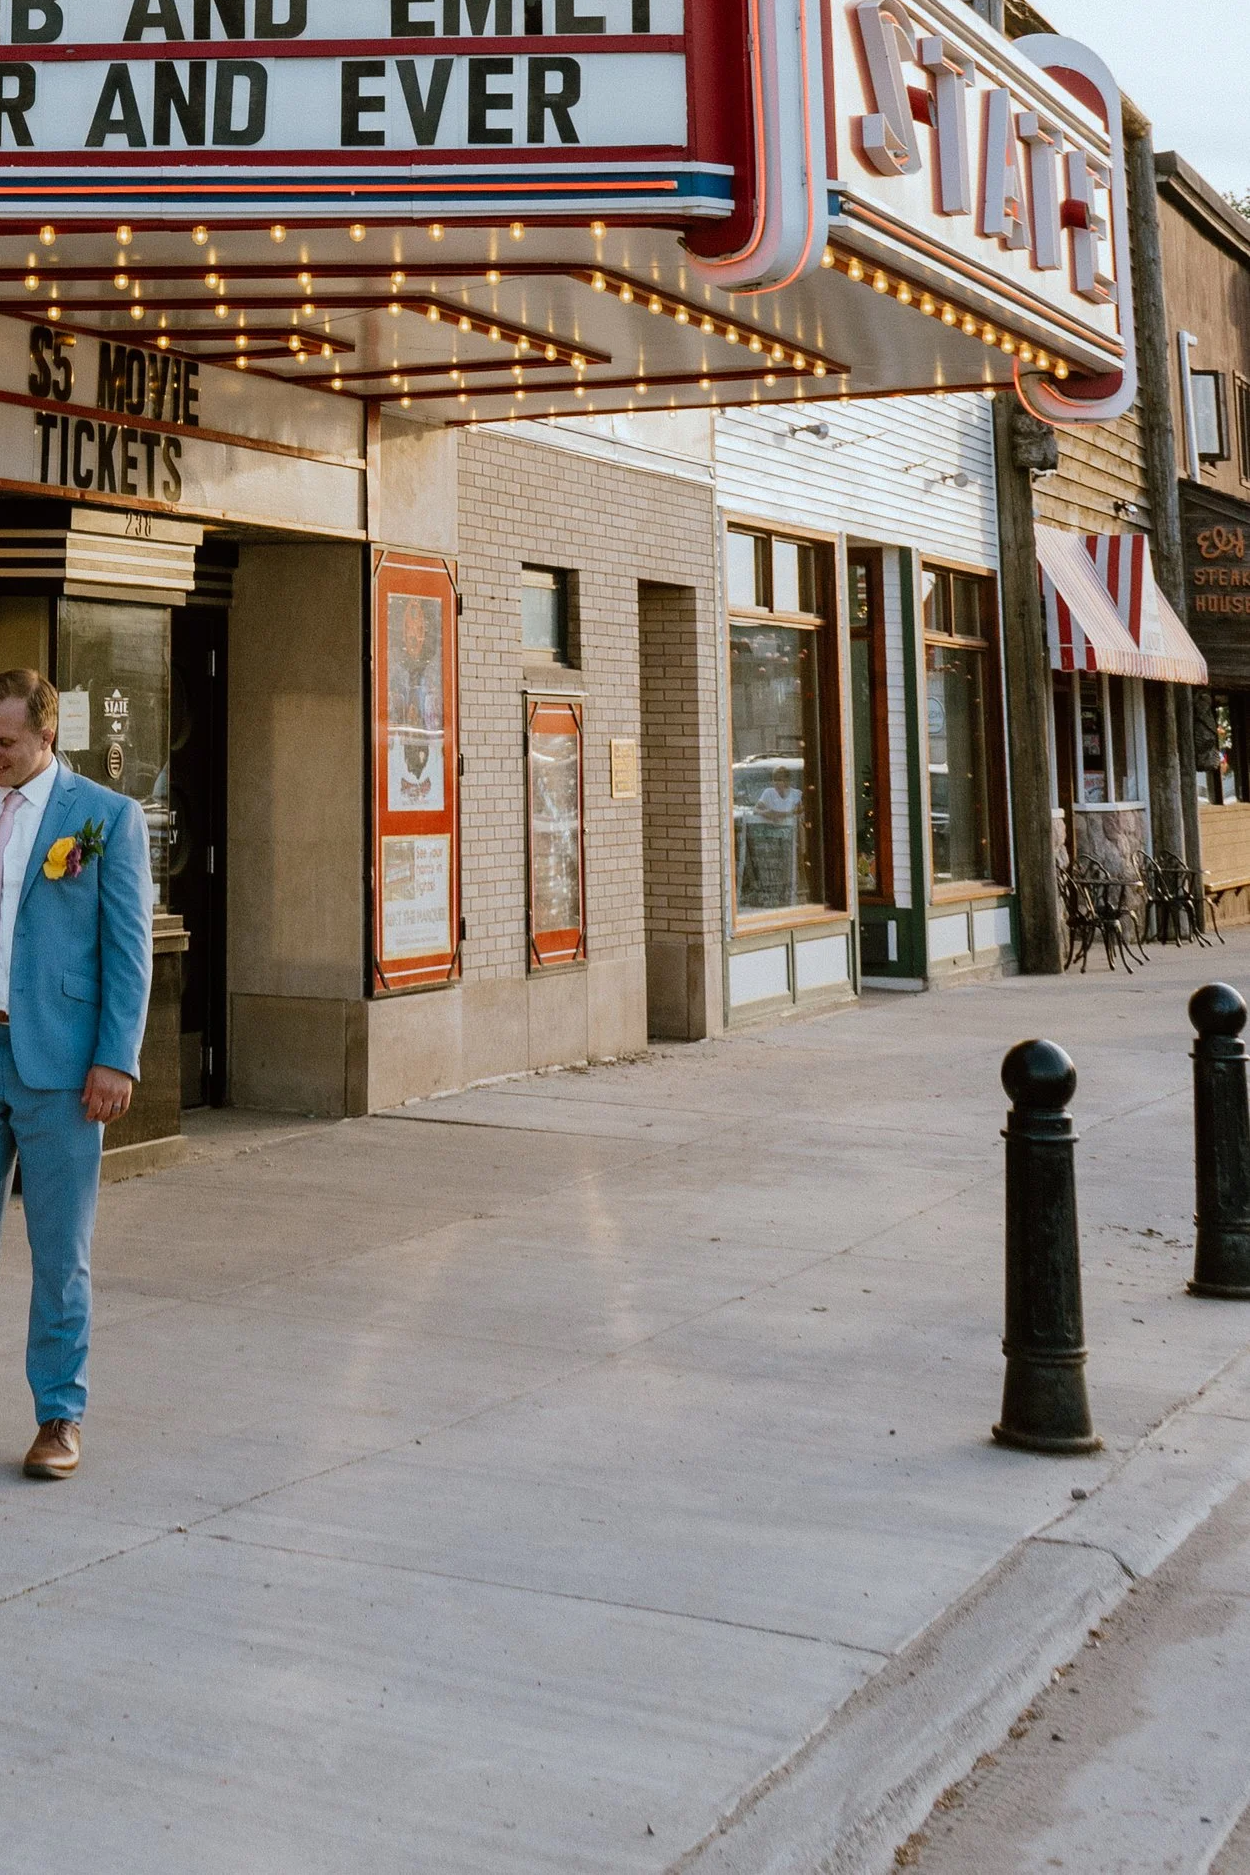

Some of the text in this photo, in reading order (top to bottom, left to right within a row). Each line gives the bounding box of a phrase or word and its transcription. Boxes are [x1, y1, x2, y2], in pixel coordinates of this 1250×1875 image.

[84, 60, 268, 148] AND
[340, 56, 581, 146] EVER
[97, 340, 199, 427] MOVIE
[35, 411, 183, 502] TICKETS
[1196, 526, 1245, 559] Ely
[104, 700, 129, 713] STATE
